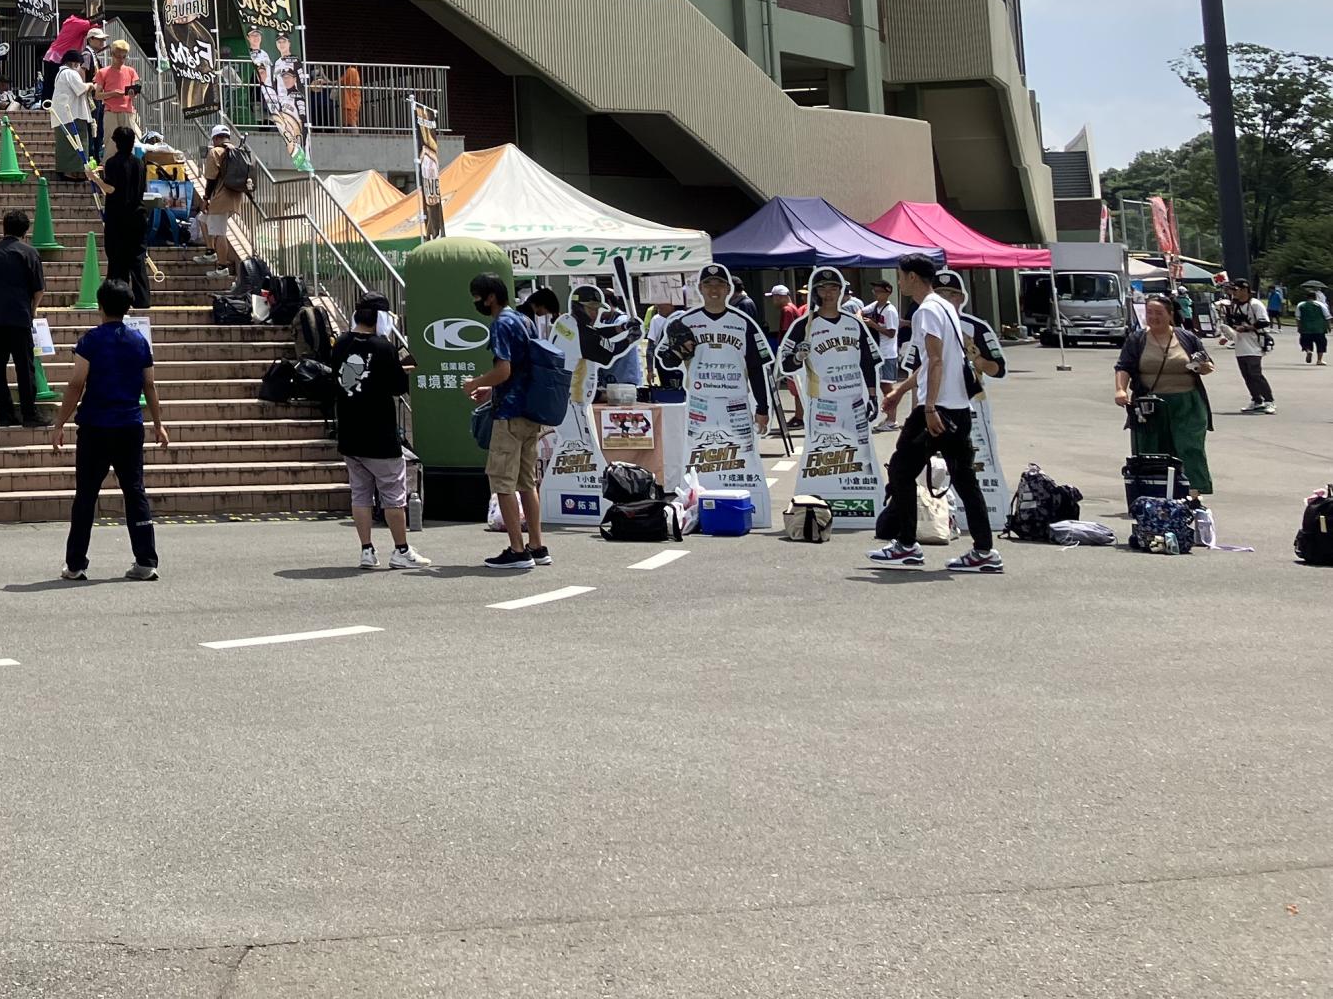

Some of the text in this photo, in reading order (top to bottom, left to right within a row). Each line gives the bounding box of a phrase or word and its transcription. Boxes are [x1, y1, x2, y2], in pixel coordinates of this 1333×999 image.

[717, 333, 744, 350] BRAVES
[814, 337, 841, 355] GOLDEN
[555, 452, 593, 467] FIGHT
[689, 445, 740, 464] FIGHT
[806, 449, 858, 467] FIGHT
[802, 462, 863, 478] TOGETHER
